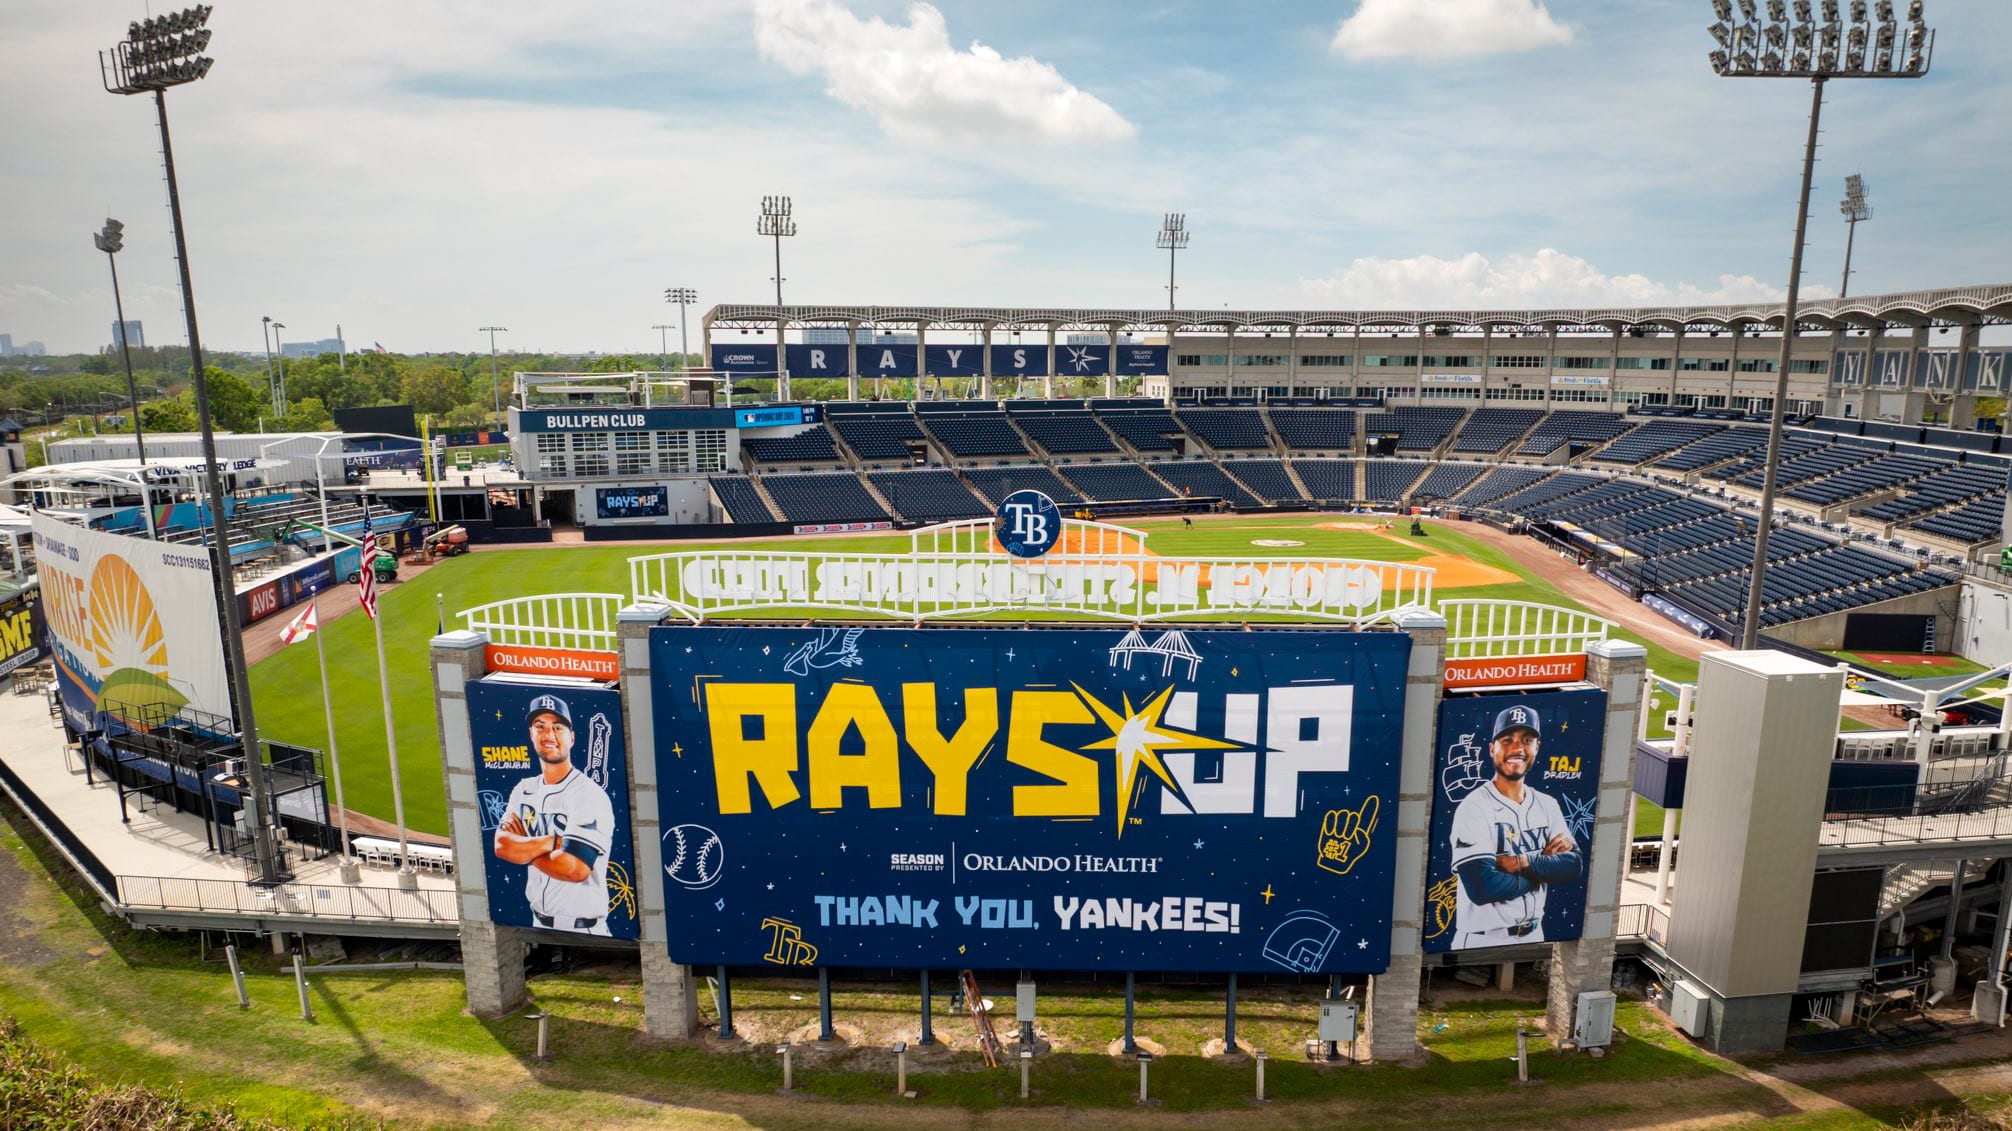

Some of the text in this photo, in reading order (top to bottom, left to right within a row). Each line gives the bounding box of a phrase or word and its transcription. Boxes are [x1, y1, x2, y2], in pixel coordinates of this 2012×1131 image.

[547, 414, 645, 428] BULLPEN CLUB
[233, 460, 256, 470] LEDGE
[346, 455, 381, 466] EALTH
[606, 496, 639, 508] RAYS
[1005, 504, 1048, 544] TB
[252, 588, 276, 617] AVIS
[494, 652, 612, 673] ORLANDO HEALTH
[1444, 662, 1572, 681] ORLANDO HEALTH
[1509, 708, 1527, 724] TB
[481, 745, 530, 761] SHANE
[704, 682, 1354, 818] RAYS UP
[1549, 756, 1581, 772] TAJ
[1543, 771, 1582, 780] BRADLEY
[1323, 839, 1351, 863] #1
[891, 854, 944, 865] SEASON
[963, 853, 1158, 873] ORLANDO HEALTH
[814, 895, 1241, 934] THANK YOU, YANKEES!
